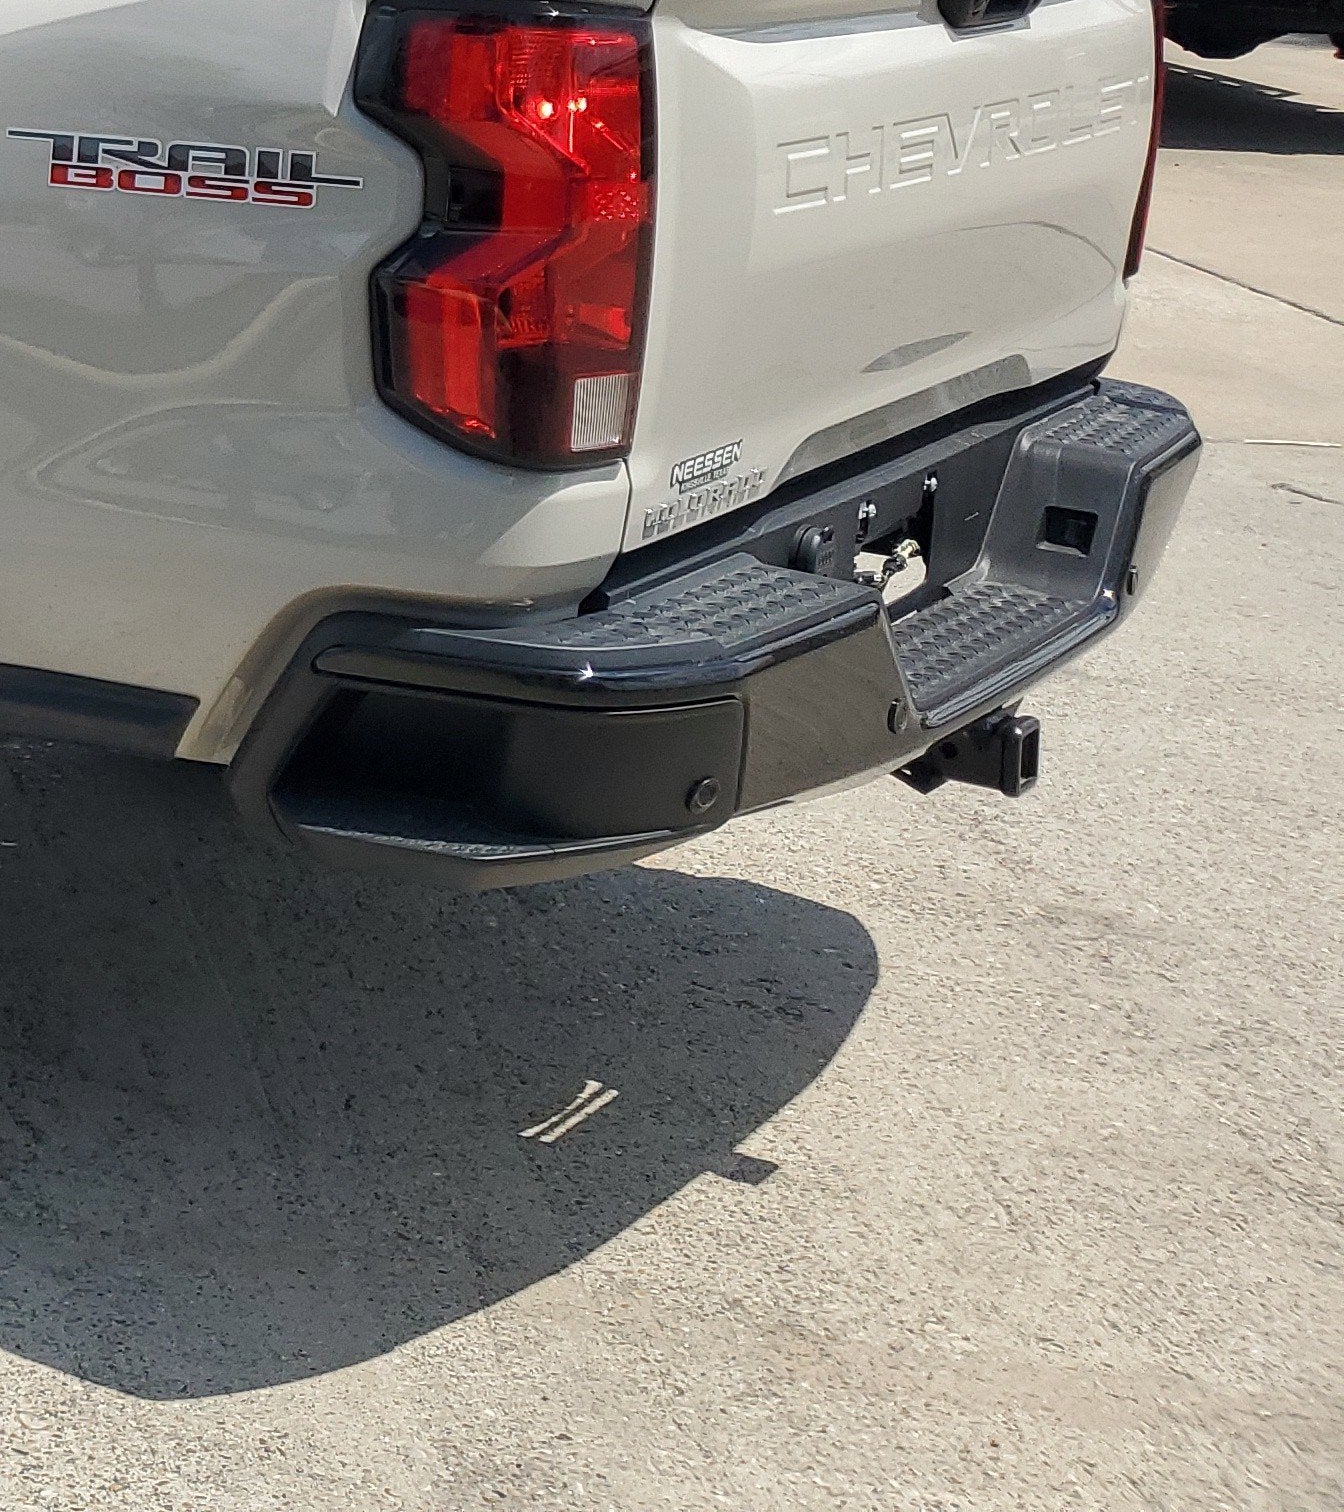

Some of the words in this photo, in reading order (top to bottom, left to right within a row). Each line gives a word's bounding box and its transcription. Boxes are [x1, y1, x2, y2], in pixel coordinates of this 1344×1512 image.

[7, 128, 363, 190] TRAIL
[773, 73, 1150, 216] CHEVROLET
[48, 161, 316, 208] BOSS
[670, 441, 743, 488] NEESSEN
